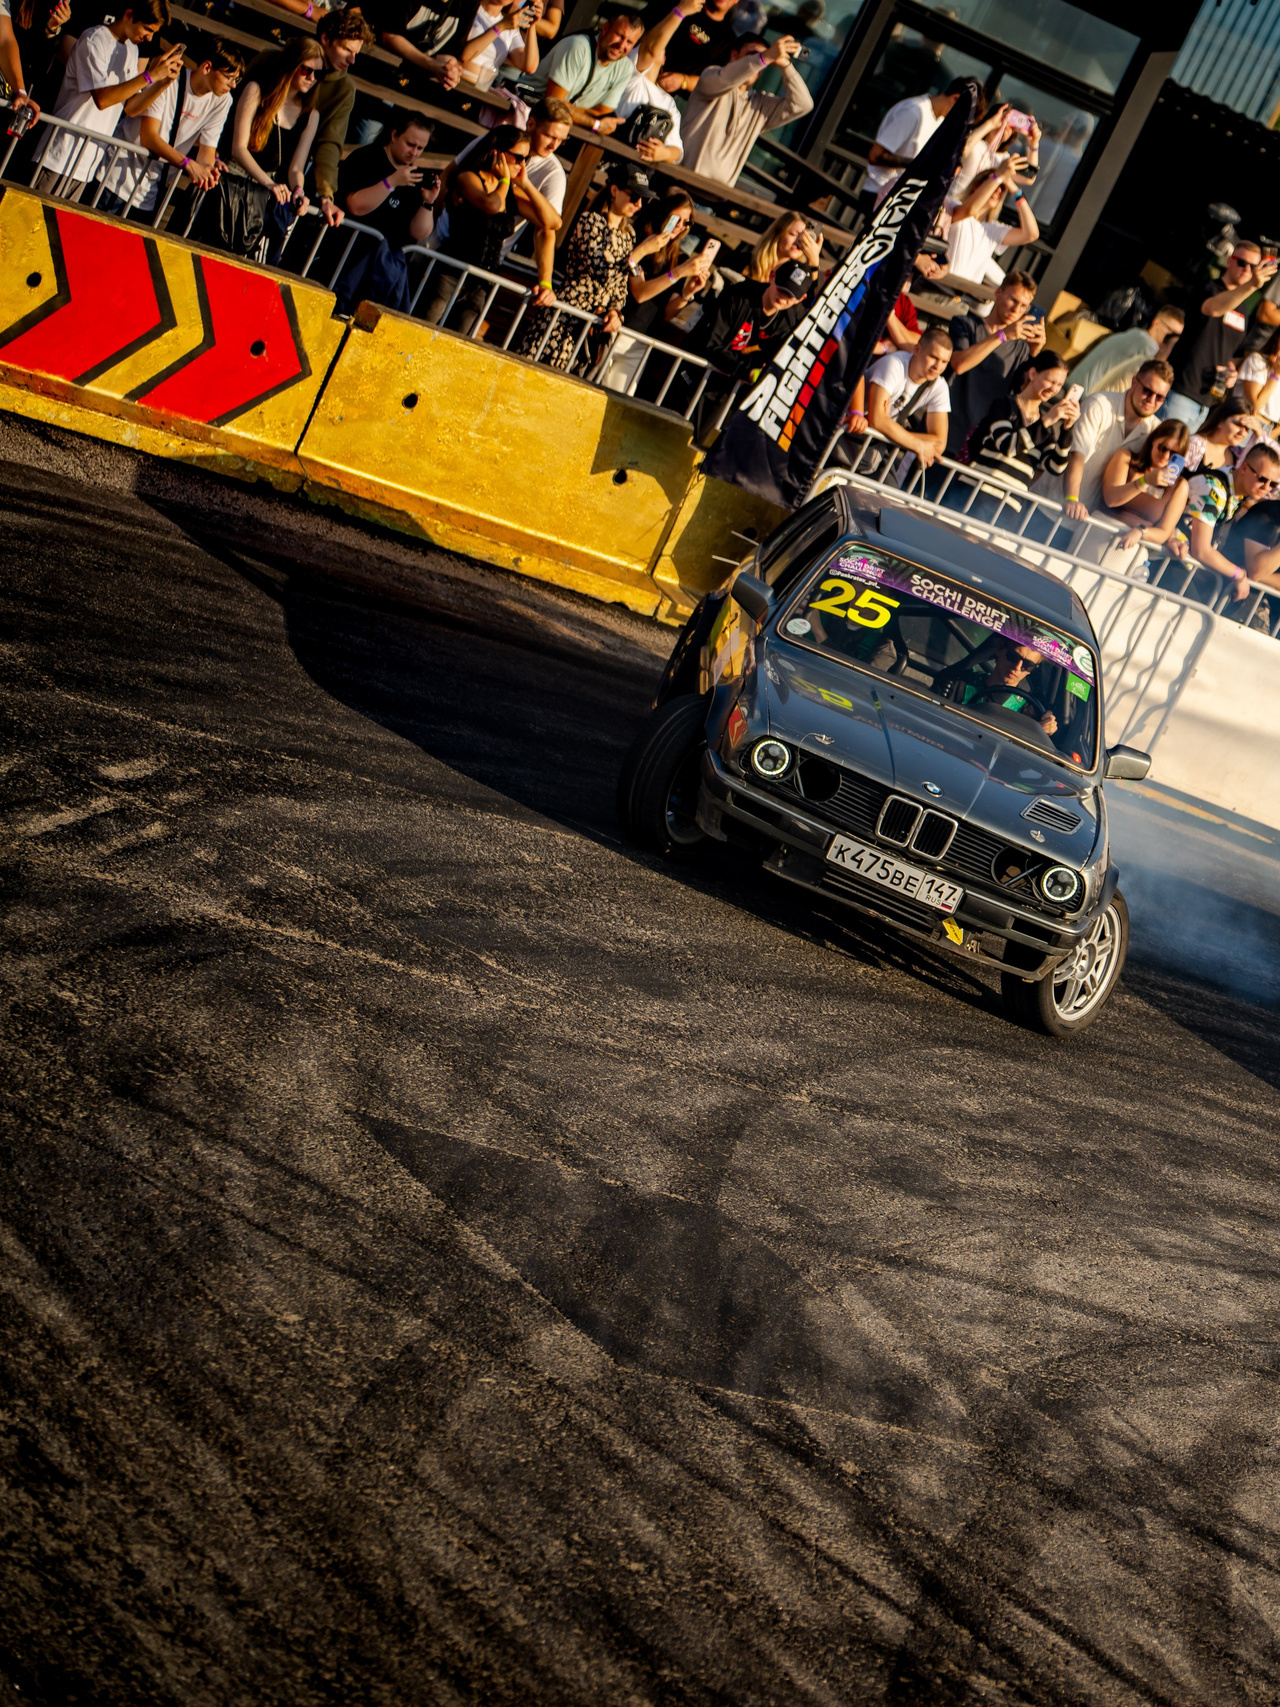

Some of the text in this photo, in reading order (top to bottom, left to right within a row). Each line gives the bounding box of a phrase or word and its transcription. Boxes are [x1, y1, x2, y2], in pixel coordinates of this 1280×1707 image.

[758, 262, 864, 441] FIGHTERS
[808, 578, 901, 629] 25
[910, 573, 1010, 624] SOCHI DRIFT
[911, 585, 1004, 632] CHALLENGE
[925, 878, 958, 902] 147
[925, 894, 942, 906] RUS
